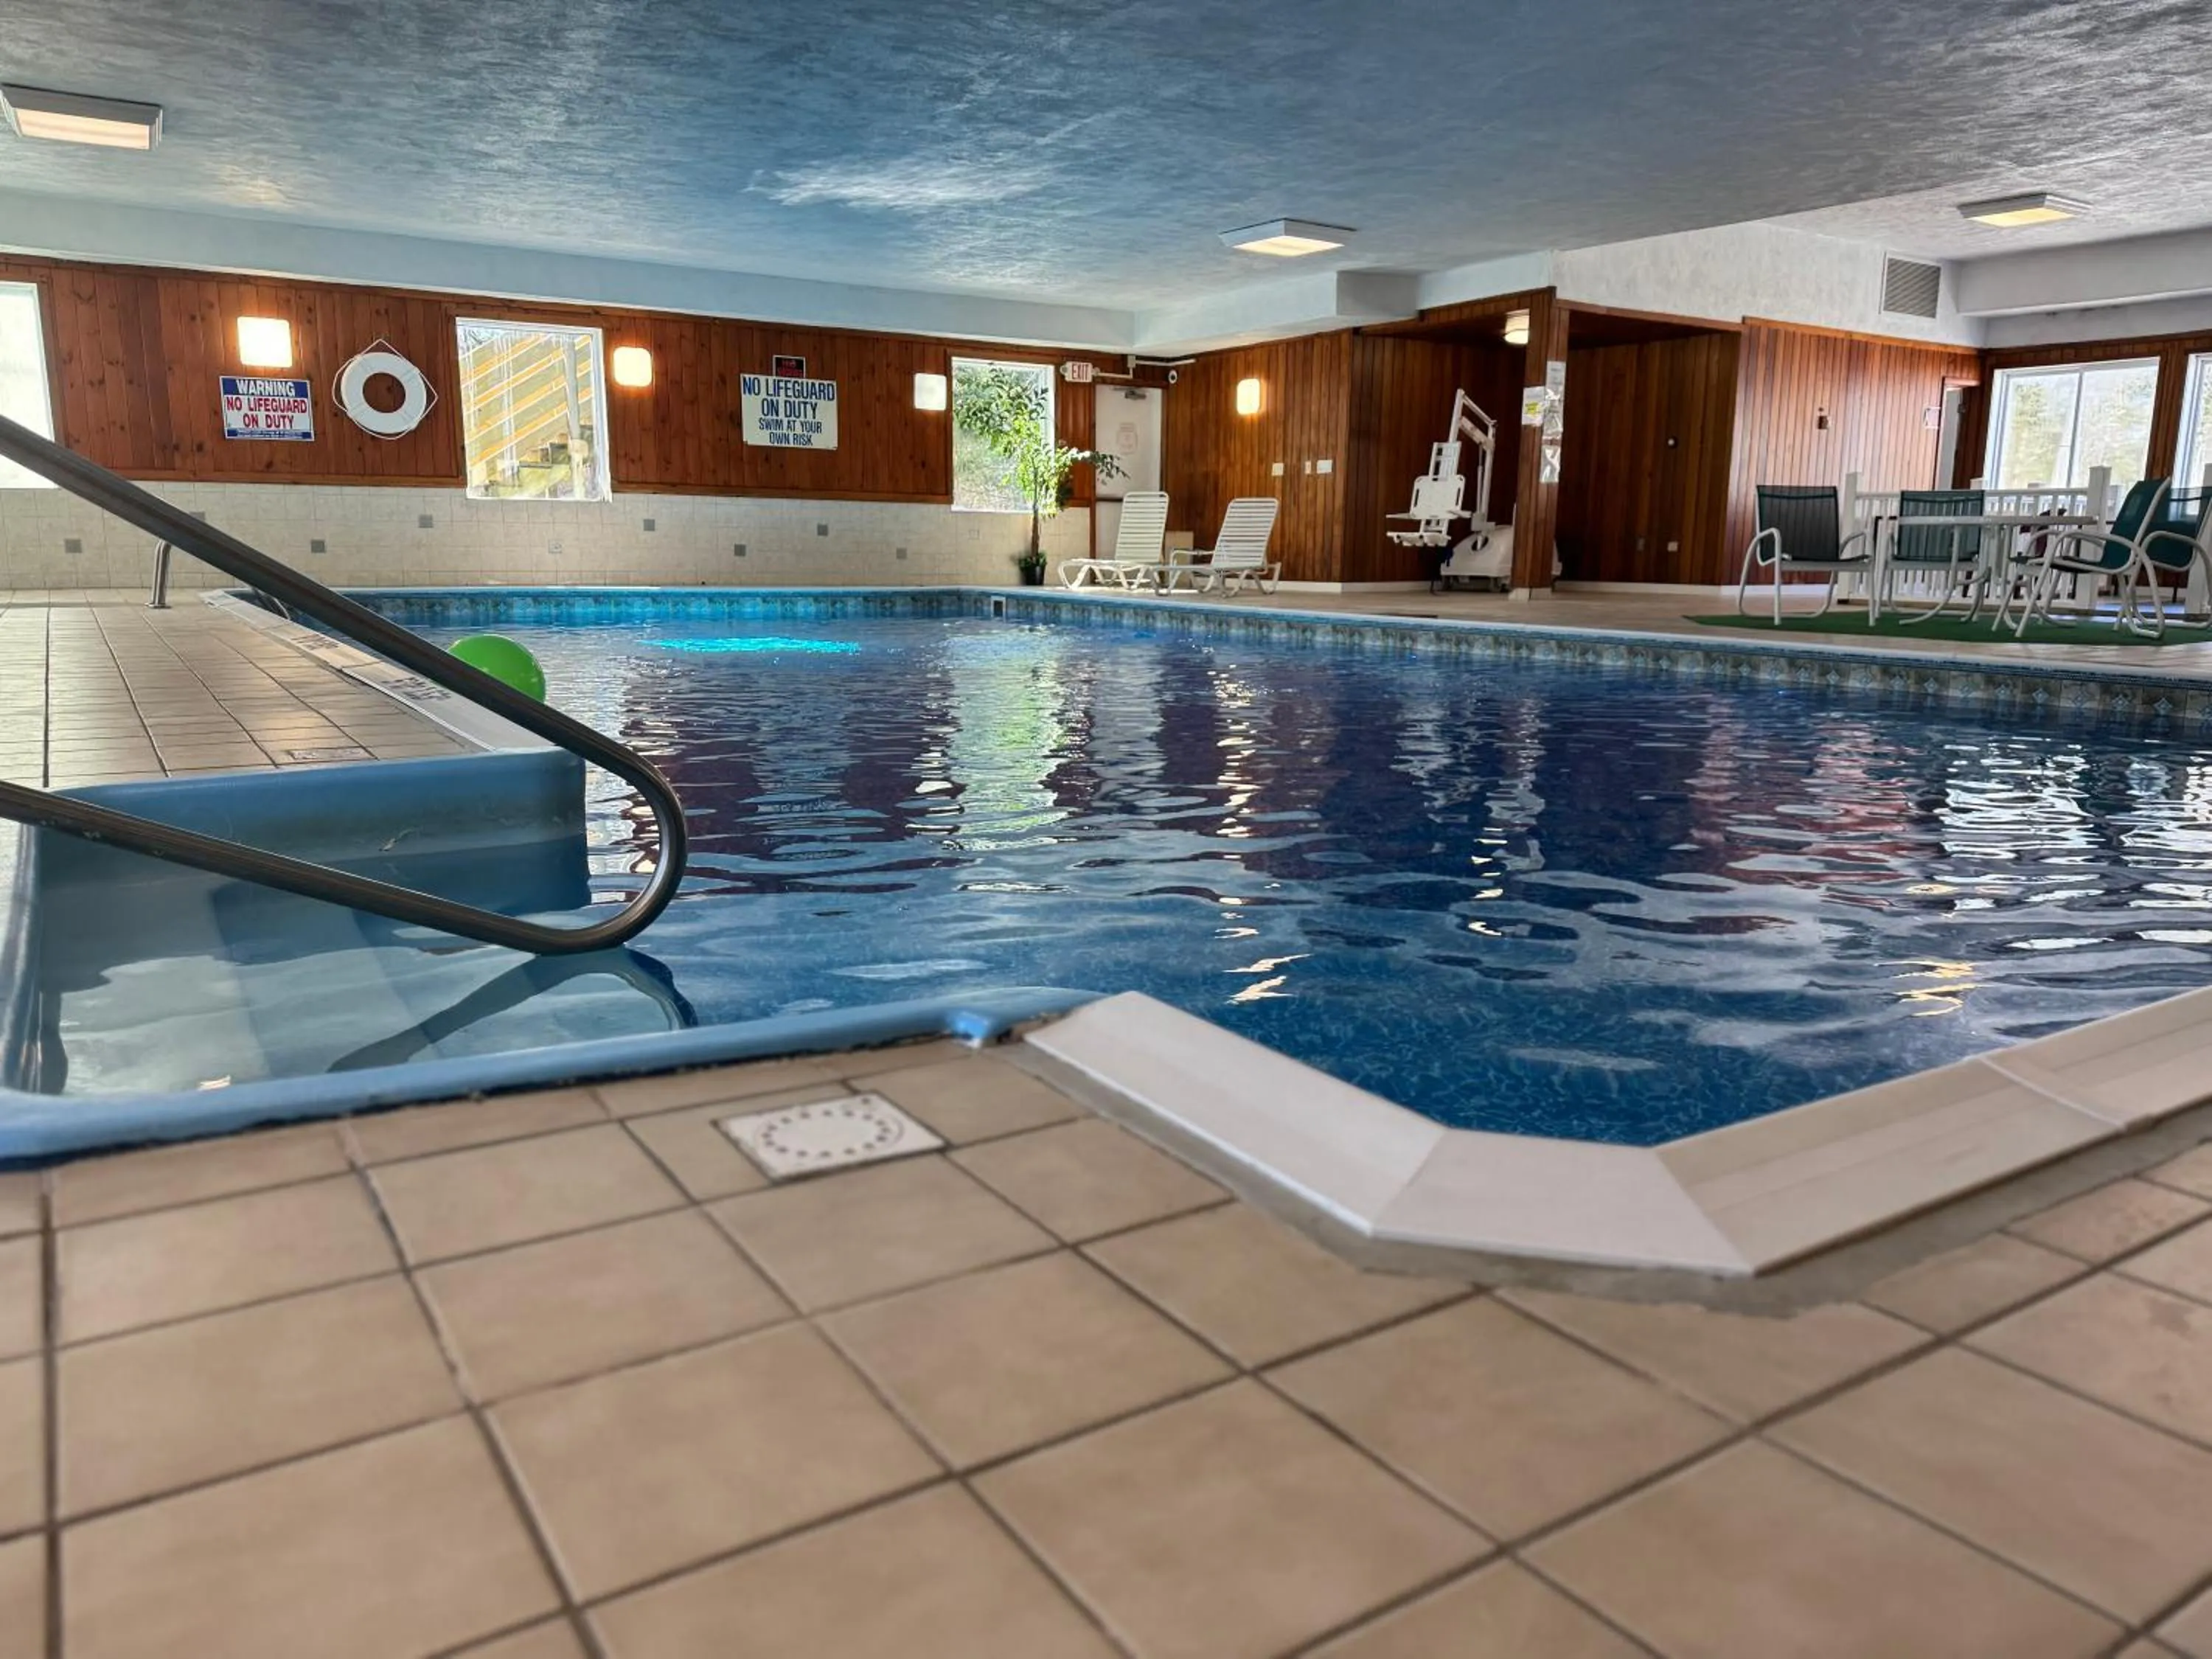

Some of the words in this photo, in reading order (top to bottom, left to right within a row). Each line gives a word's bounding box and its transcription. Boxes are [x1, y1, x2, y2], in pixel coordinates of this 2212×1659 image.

[1072, 364, 1089, 380] EXIT
[237, 380, 295, 396] WARNING
[742, 377, 760, 395] NO
[765, 378, 835, 401] LIFEGUARD
[226, 397, 242, 411] NO
[248, 398, 307, 413] LIFEGUARD
[762, 398, 779, 417] ON
[784, 400, 818, 420] DUTY
[243, 413, 258, 428] ON
[265, 414, 293, 429] DUTY
[759, 417, 784, 431] SWIM
[786, 419, 797, 432] AT
[800, 420, 822, 434] YOUR
[769, 432, 790, 445] OWN
[793, 434, 813, 446] RISK
